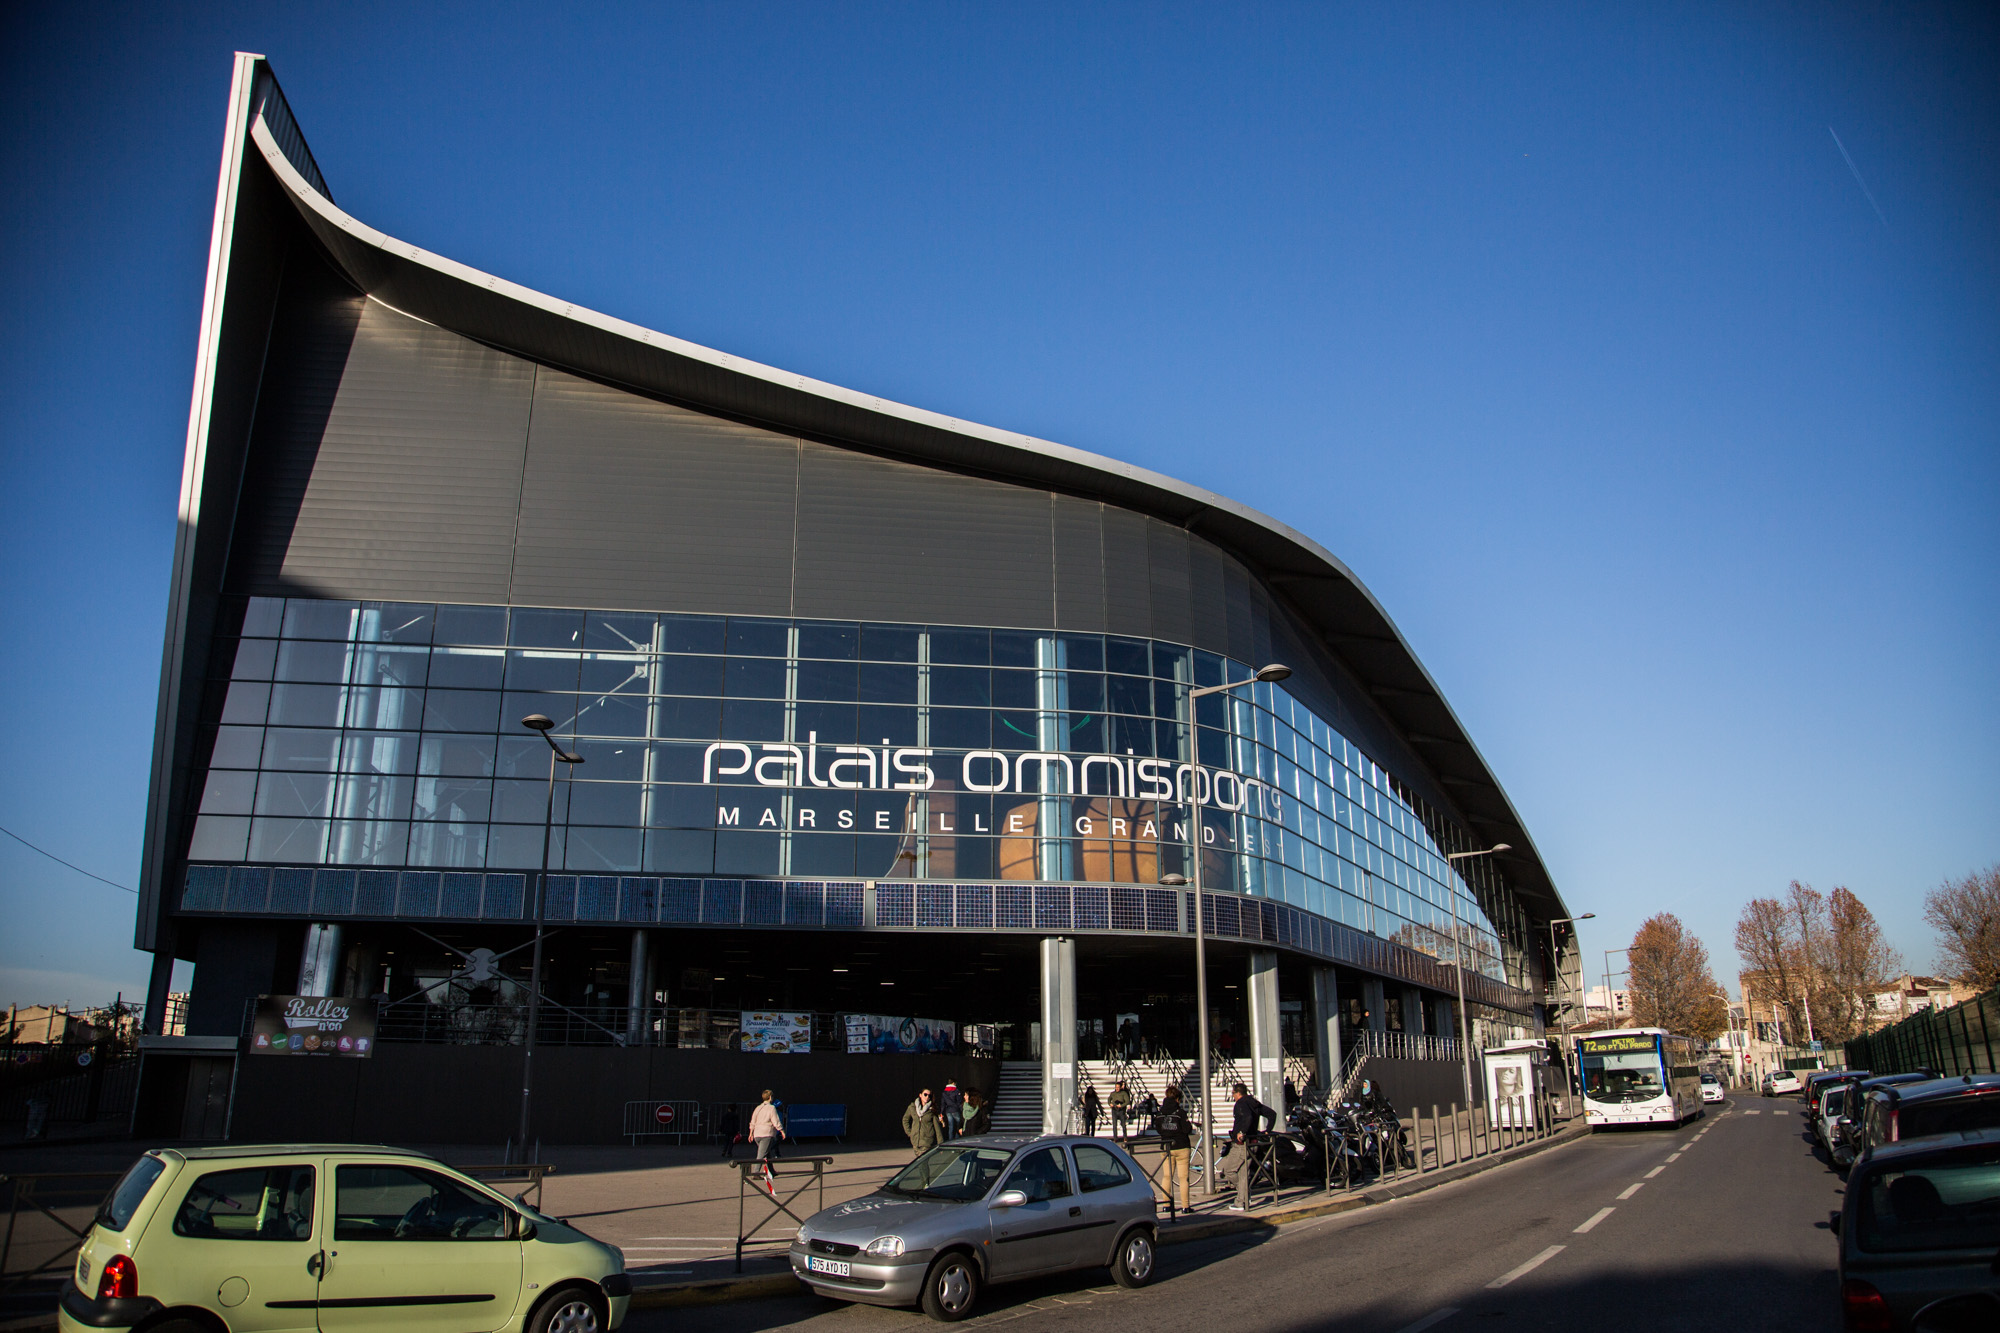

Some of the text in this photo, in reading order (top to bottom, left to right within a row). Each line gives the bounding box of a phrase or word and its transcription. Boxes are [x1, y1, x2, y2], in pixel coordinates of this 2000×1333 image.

[703, 731, 1286, 827] palais omnisports
[718, 806, 1284, 859] MARSEILLE GRAND-EST
[284, 998, 349, 1020] Roller
[1584, 1041, 1597, 1051] 72
[1630, 1041, 1652, 1049] PRADO
[1612, 1038, 1635, 1046] METRO
[812, 1259, 848, 1275] 575 AYD 13
